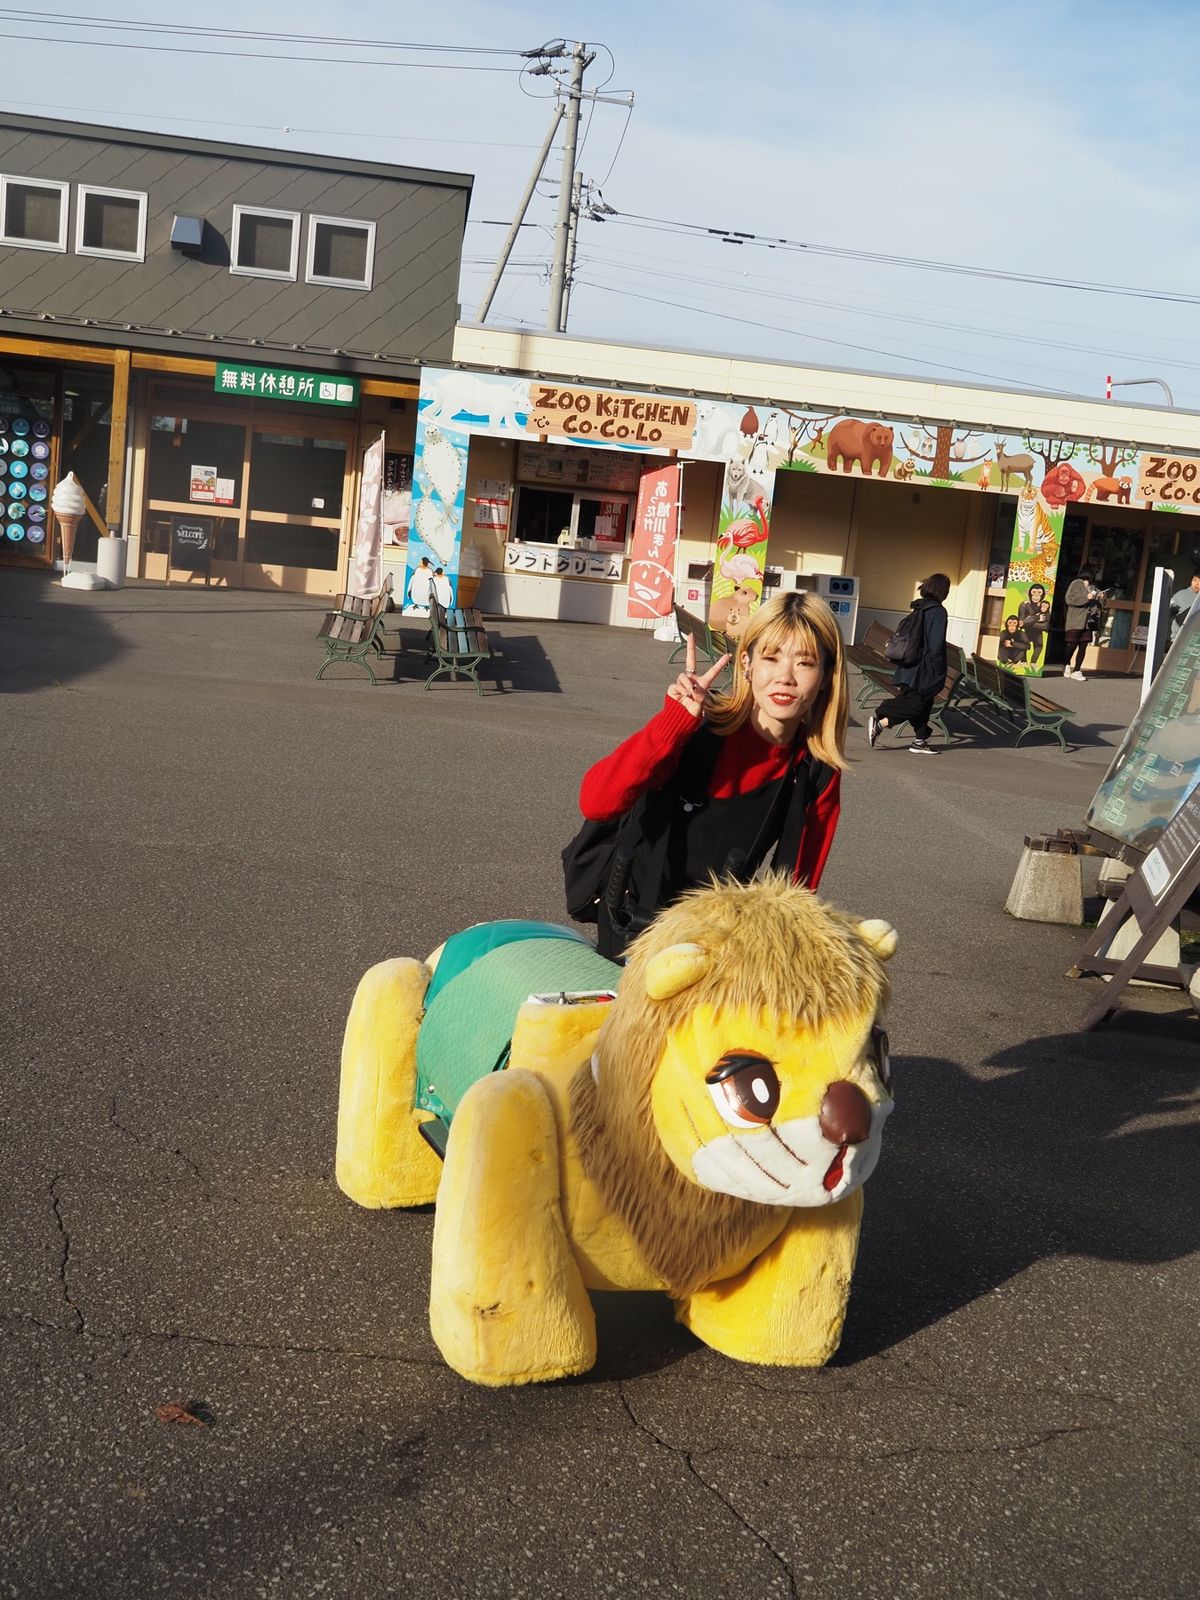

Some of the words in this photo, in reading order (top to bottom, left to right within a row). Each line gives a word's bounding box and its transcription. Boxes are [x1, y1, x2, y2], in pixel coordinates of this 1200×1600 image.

[222, 369, 314, 398] 無料休憩所
[535, 387, 591, 413] ZOO
[1145, 456, 1198, 482] ZOO
[508, 553, 620, 578] ソフトクリーム
